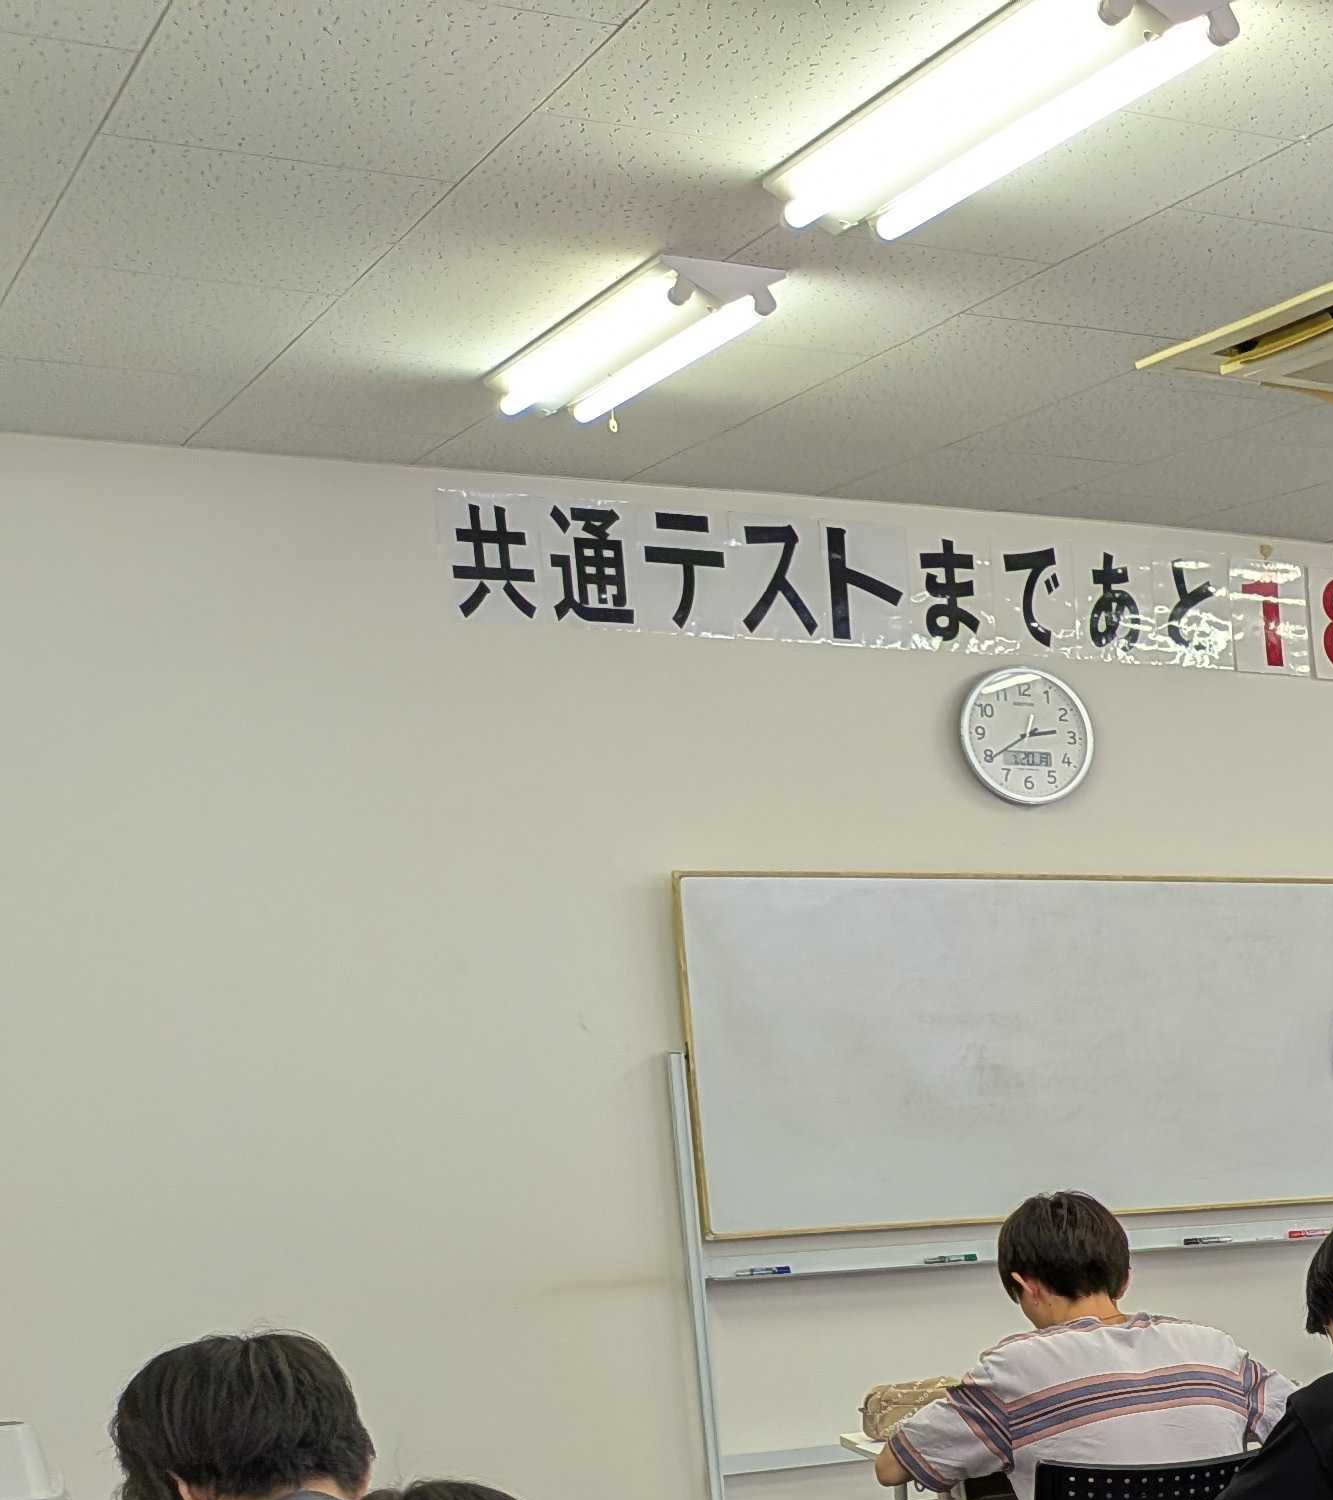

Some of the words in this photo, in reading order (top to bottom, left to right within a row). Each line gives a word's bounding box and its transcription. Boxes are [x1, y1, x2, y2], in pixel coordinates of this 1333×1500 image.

[1018, 683, 1031, 697] 12
[978, 703, 994, 718] 10
[1058, 708, 1068, 722] 2
[974, 726, 986, 740] 9
[1066, 731, 1077, 745] 3
[983, 749, 994, 763] 8
[1061, 752, 1072, 767] 4
[1001, 767, 1011, 783] 7
[1047, 769, 1057, 784] 5
[1023, 775, 1035, 790] 6
